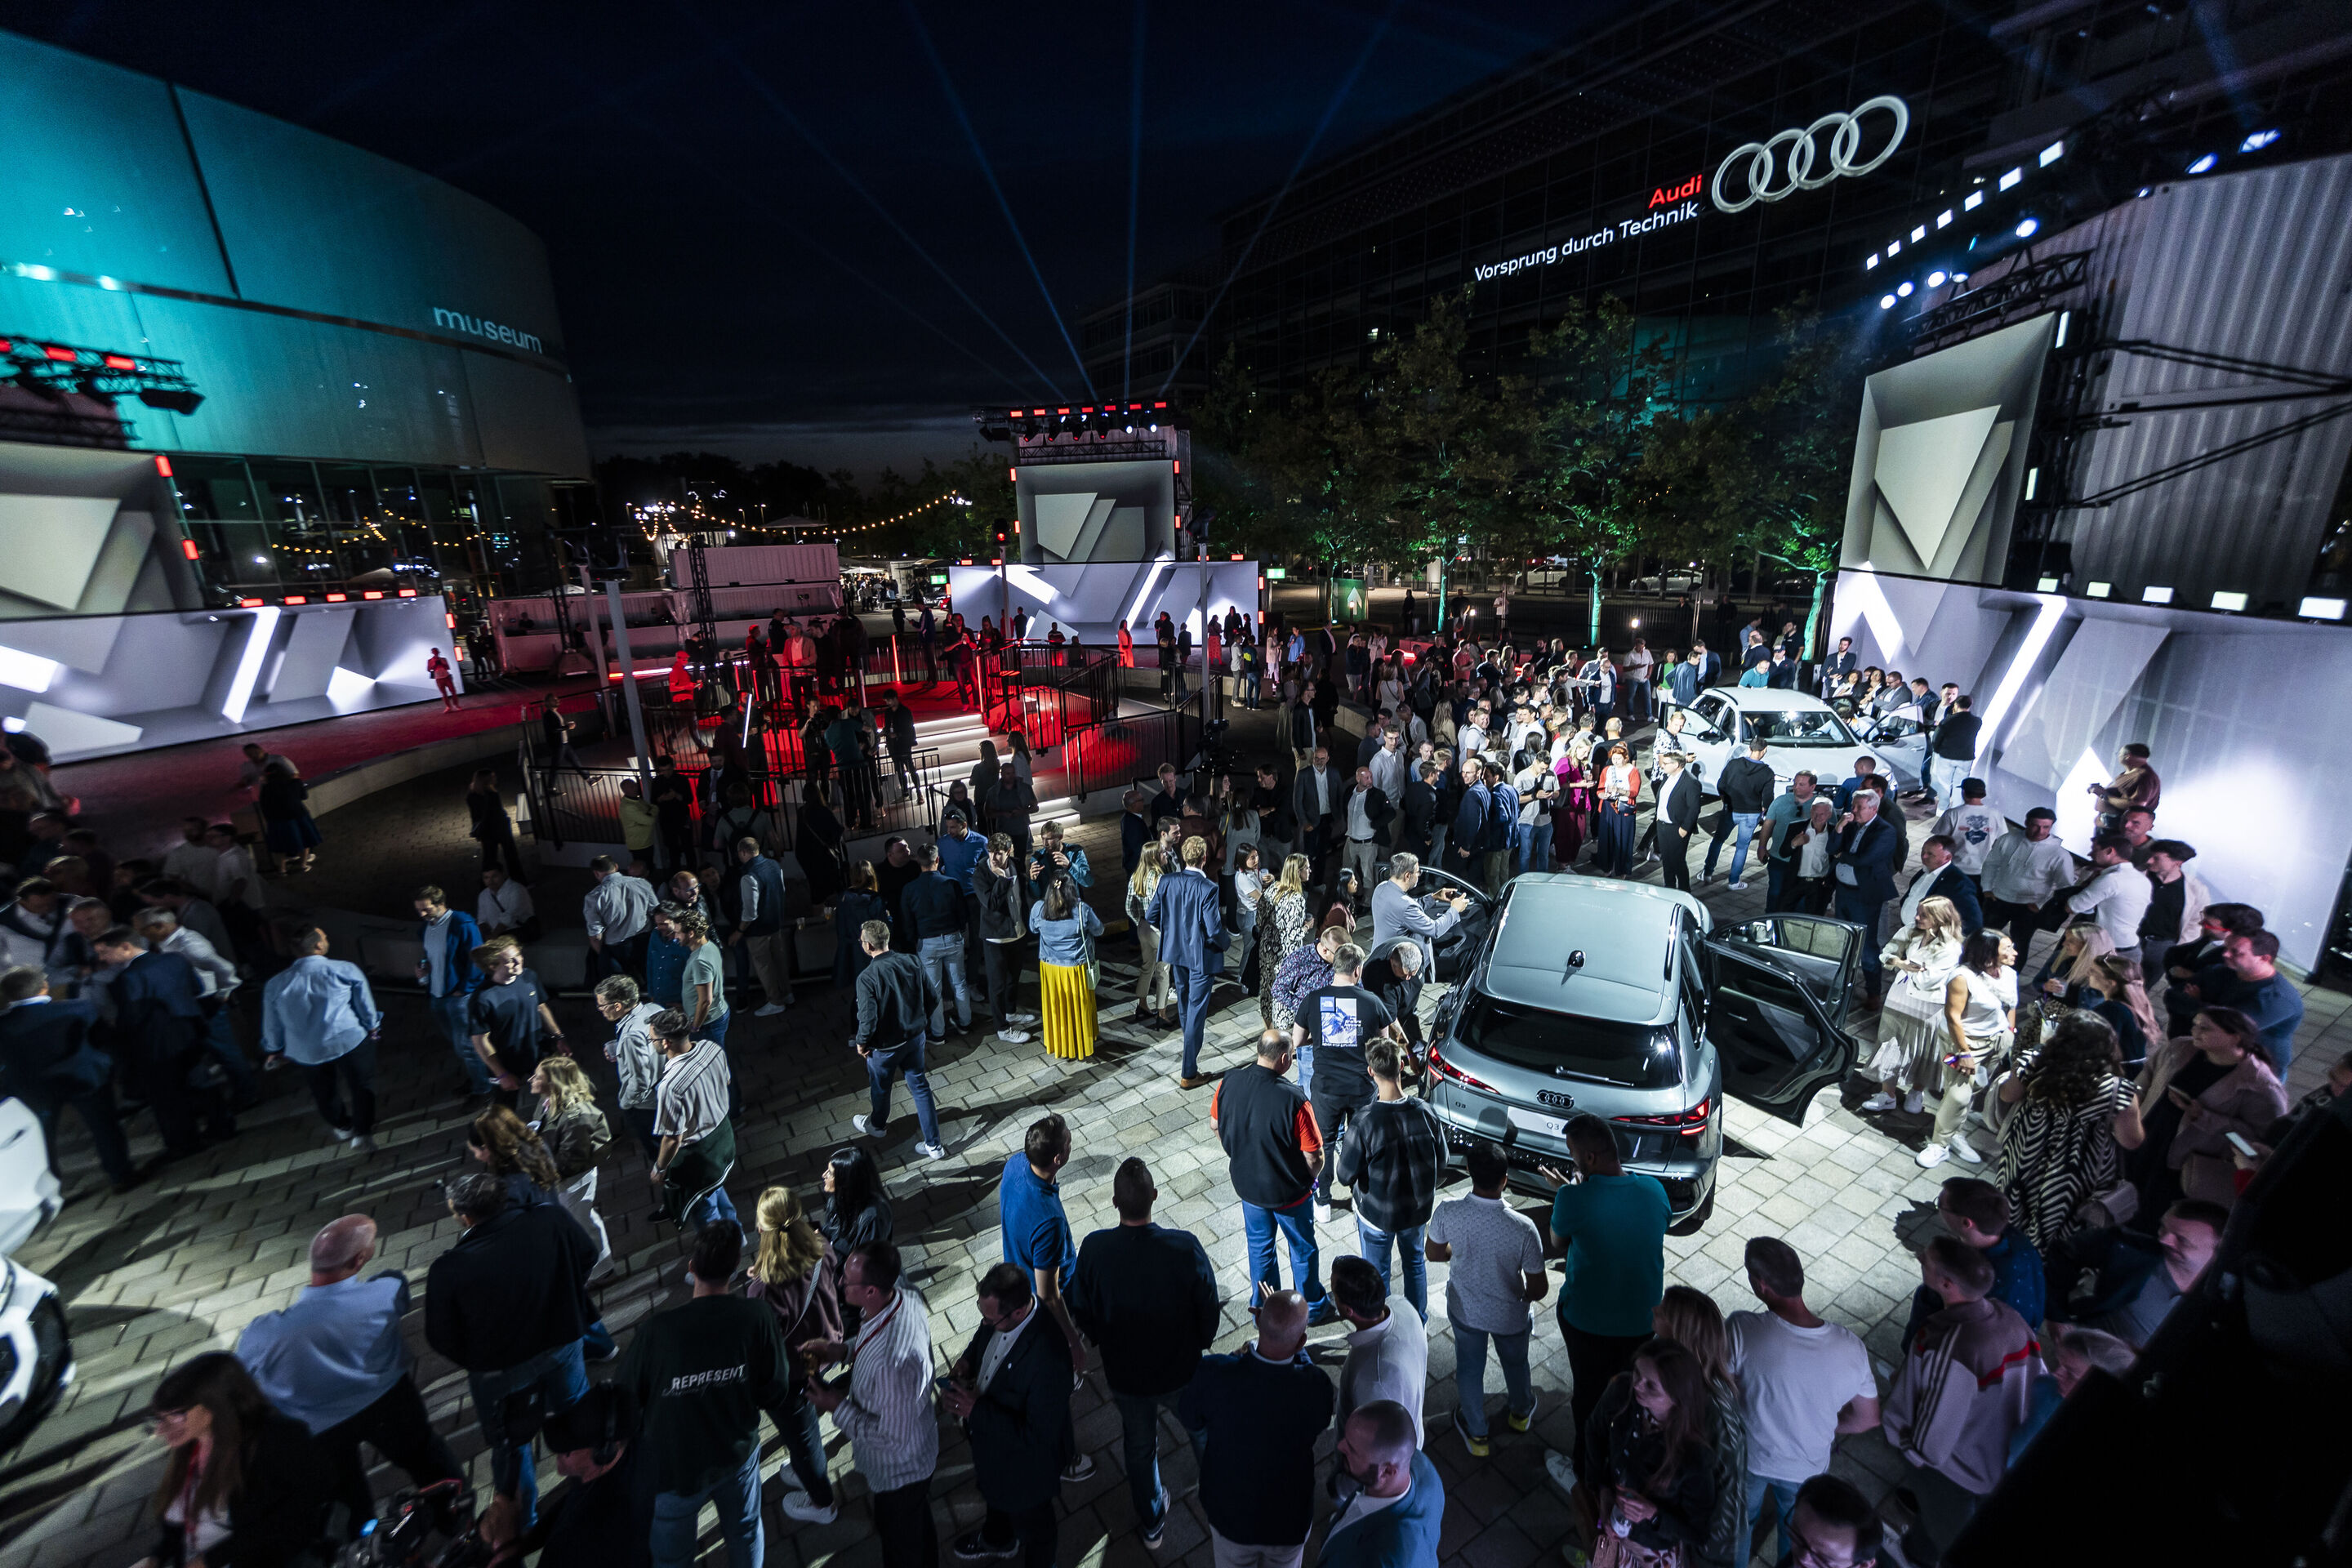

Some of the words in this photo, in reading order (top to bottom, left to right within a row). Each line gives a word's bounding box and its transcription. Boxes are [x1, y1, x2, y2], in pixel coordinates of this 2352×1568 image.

[1648, 174, 1703, 209] Audi
[1474, 247, 1557, 282] Vorsprung
[1561, 228, 1615, 256] durch
[1619, 201, 1699, 239] Technik
[434, 307, 542, 354] museum
[1546, 1121, 1561, 1130] Q3
[671, 1364, 746, 1390] REPRESENT
